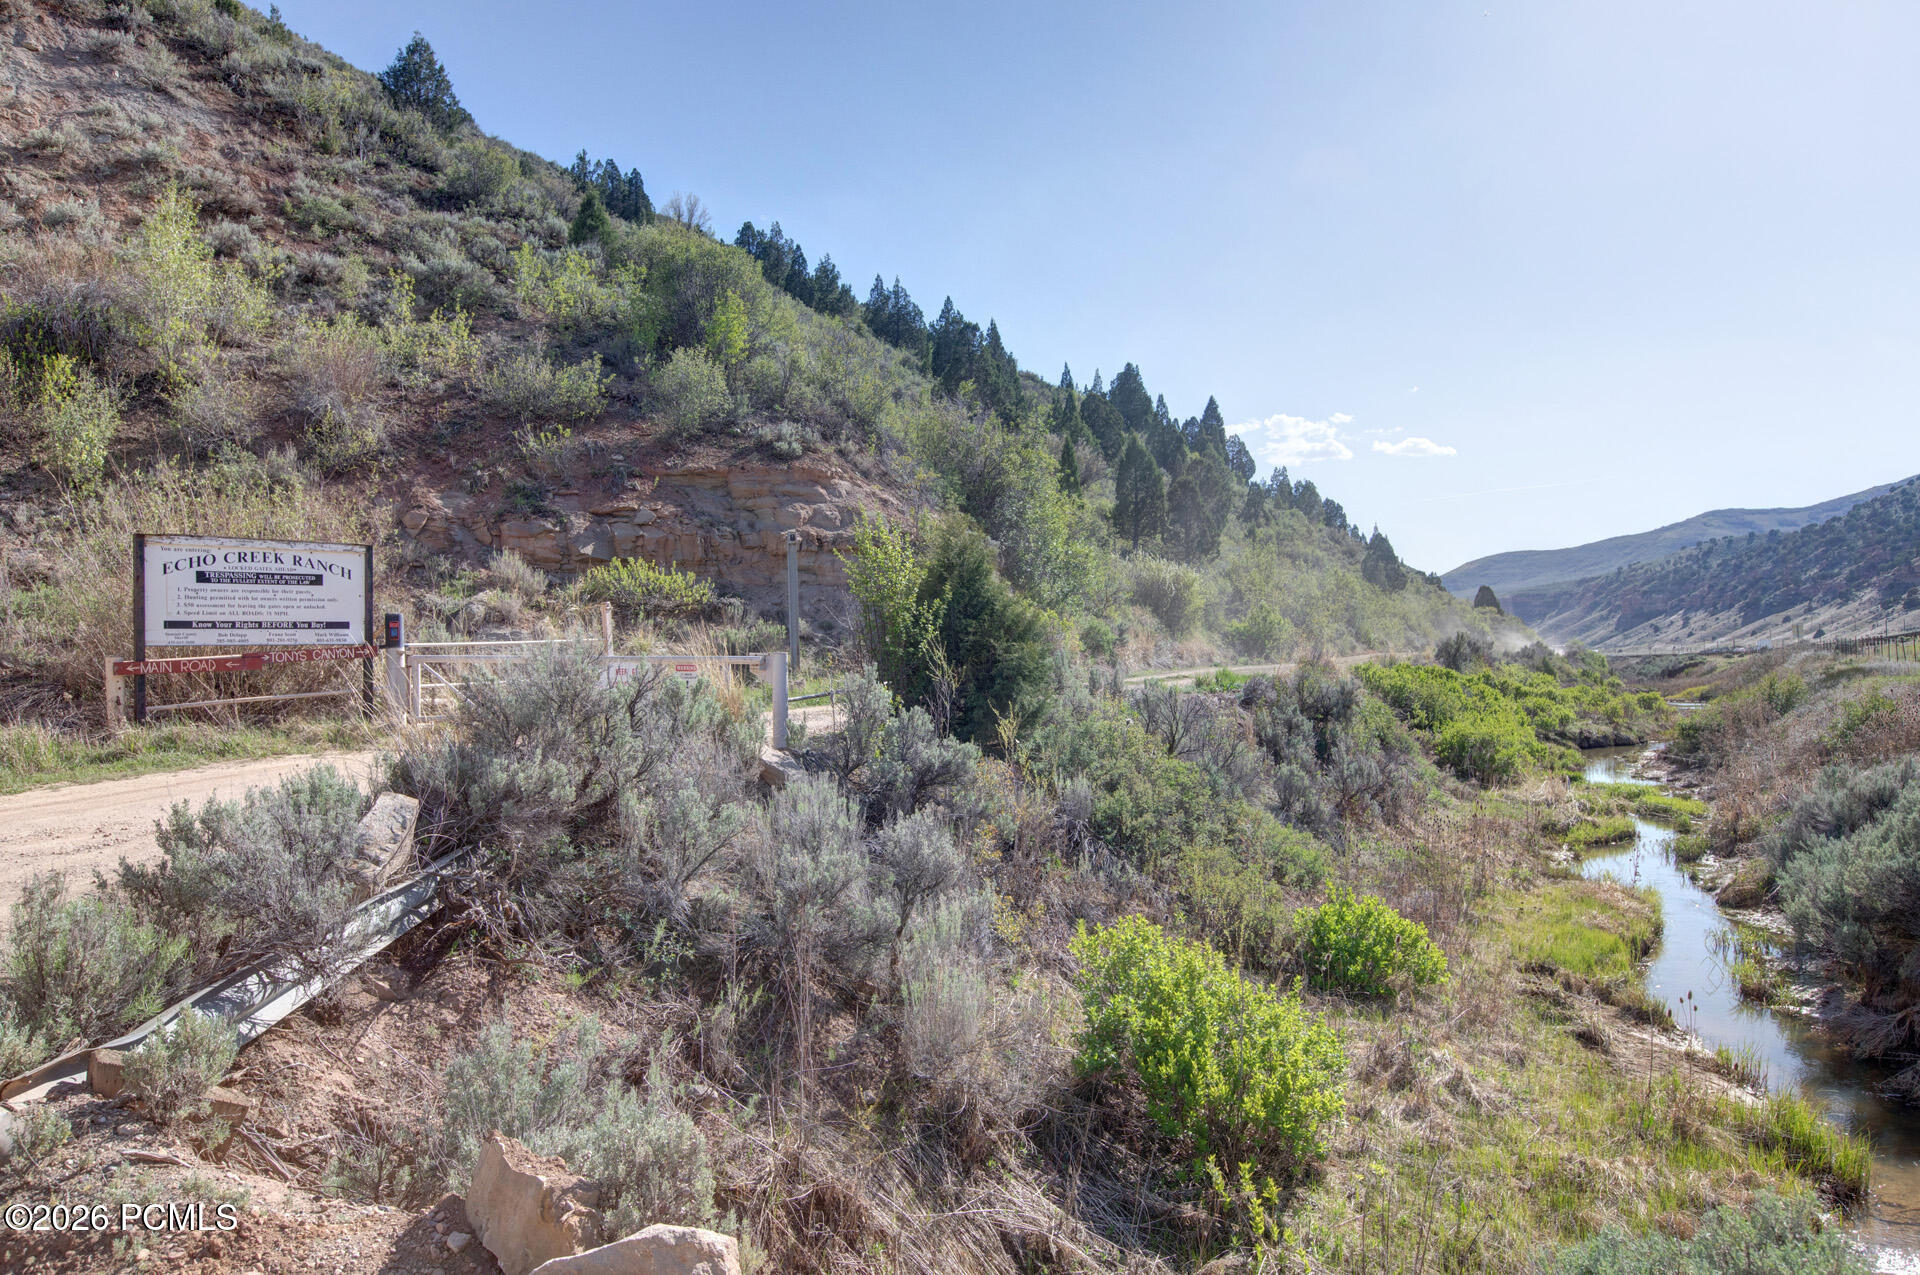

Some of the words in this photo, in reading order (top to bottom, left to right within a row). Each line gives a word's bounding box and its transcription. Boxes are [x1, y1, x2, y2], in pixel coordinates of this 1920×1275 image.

[162, 553, 216, 575] ECHO
[224, 551, 284, 565] CREEK
[292, 554, 352, 580] RANCH
[205, 571, 257, 579] TRESPASSING
[184, 594, 208, 602] Hunting
[192, 620, 213, 629] Know
[215, 620, 232, 629] Your
[235, 620, 259, 629] Rights
[261, 621, 294, 629] BEFORE
[297, 621, 309, 629] You
[311, 621, 327, 630] Buy!
[270, 651, 307, 663] TONYS
[312, 649, 354, 661] CANYON
[140, 661, 172, 673] MAIN
[180, 659, 216, 672] ROAD
